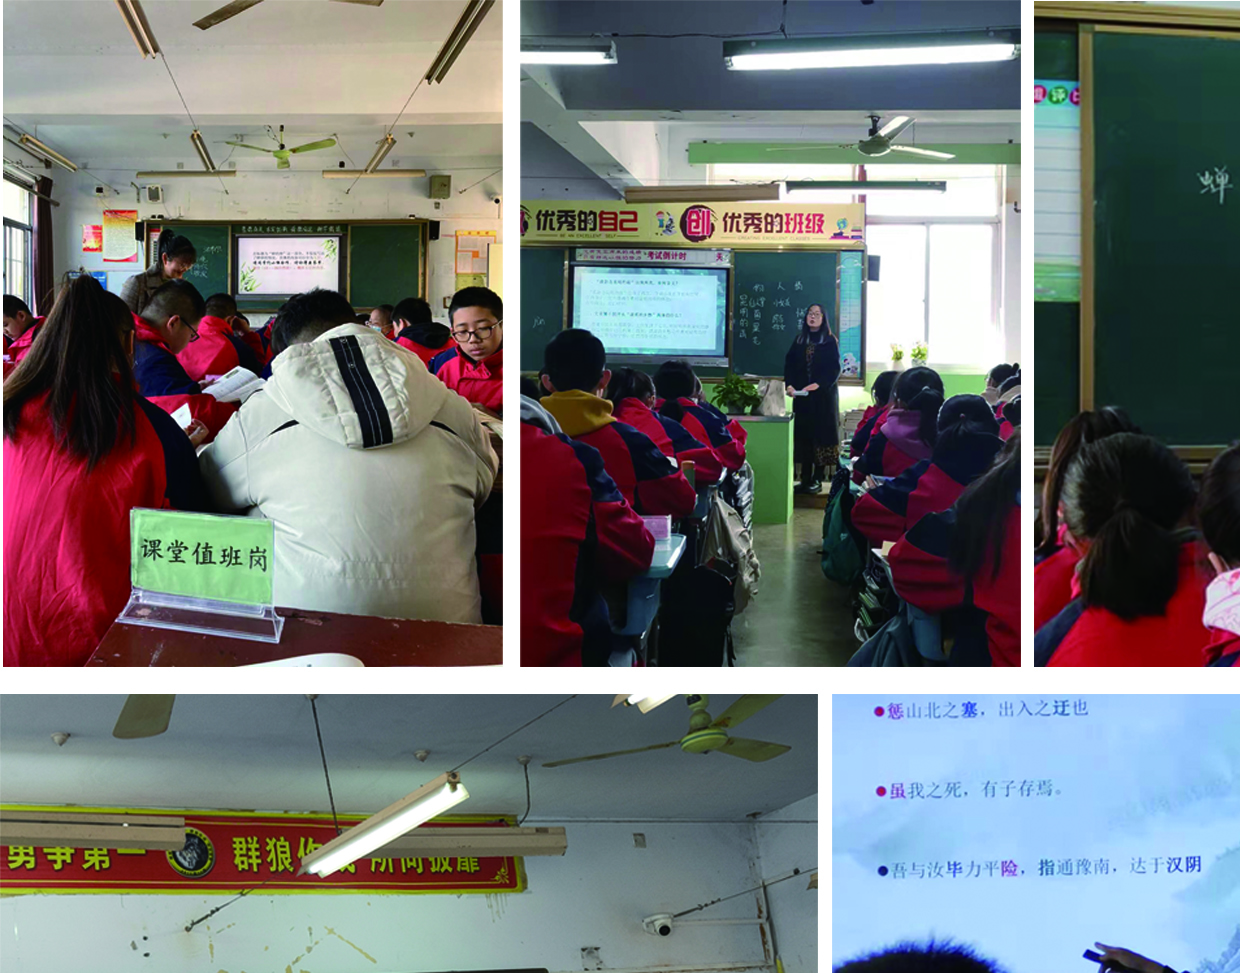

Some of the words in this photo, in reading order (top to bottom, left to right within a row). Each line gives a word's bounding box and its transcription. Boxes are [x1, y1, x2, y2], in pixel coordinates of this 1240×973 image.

[1197, 165, 1233, 205] 蝉
[536, 209, 638, 232] 优秀的自己
[686, 209, 711, 237] 创
[722, 212, 825, 234] 优秀的班级
[647, 250, 687, 261] 考试倒计时
[141, 538, 268, 573] 课堂值班岗
[887, 698, 1089, 720] 惩山北之塞，出入之迂也
[890, 779, 1062, 801] 虽我之死，有子存焉。
[891, 855, 1202, 880] 吾与汝毕力平险，指通豫南，达于汉阴
